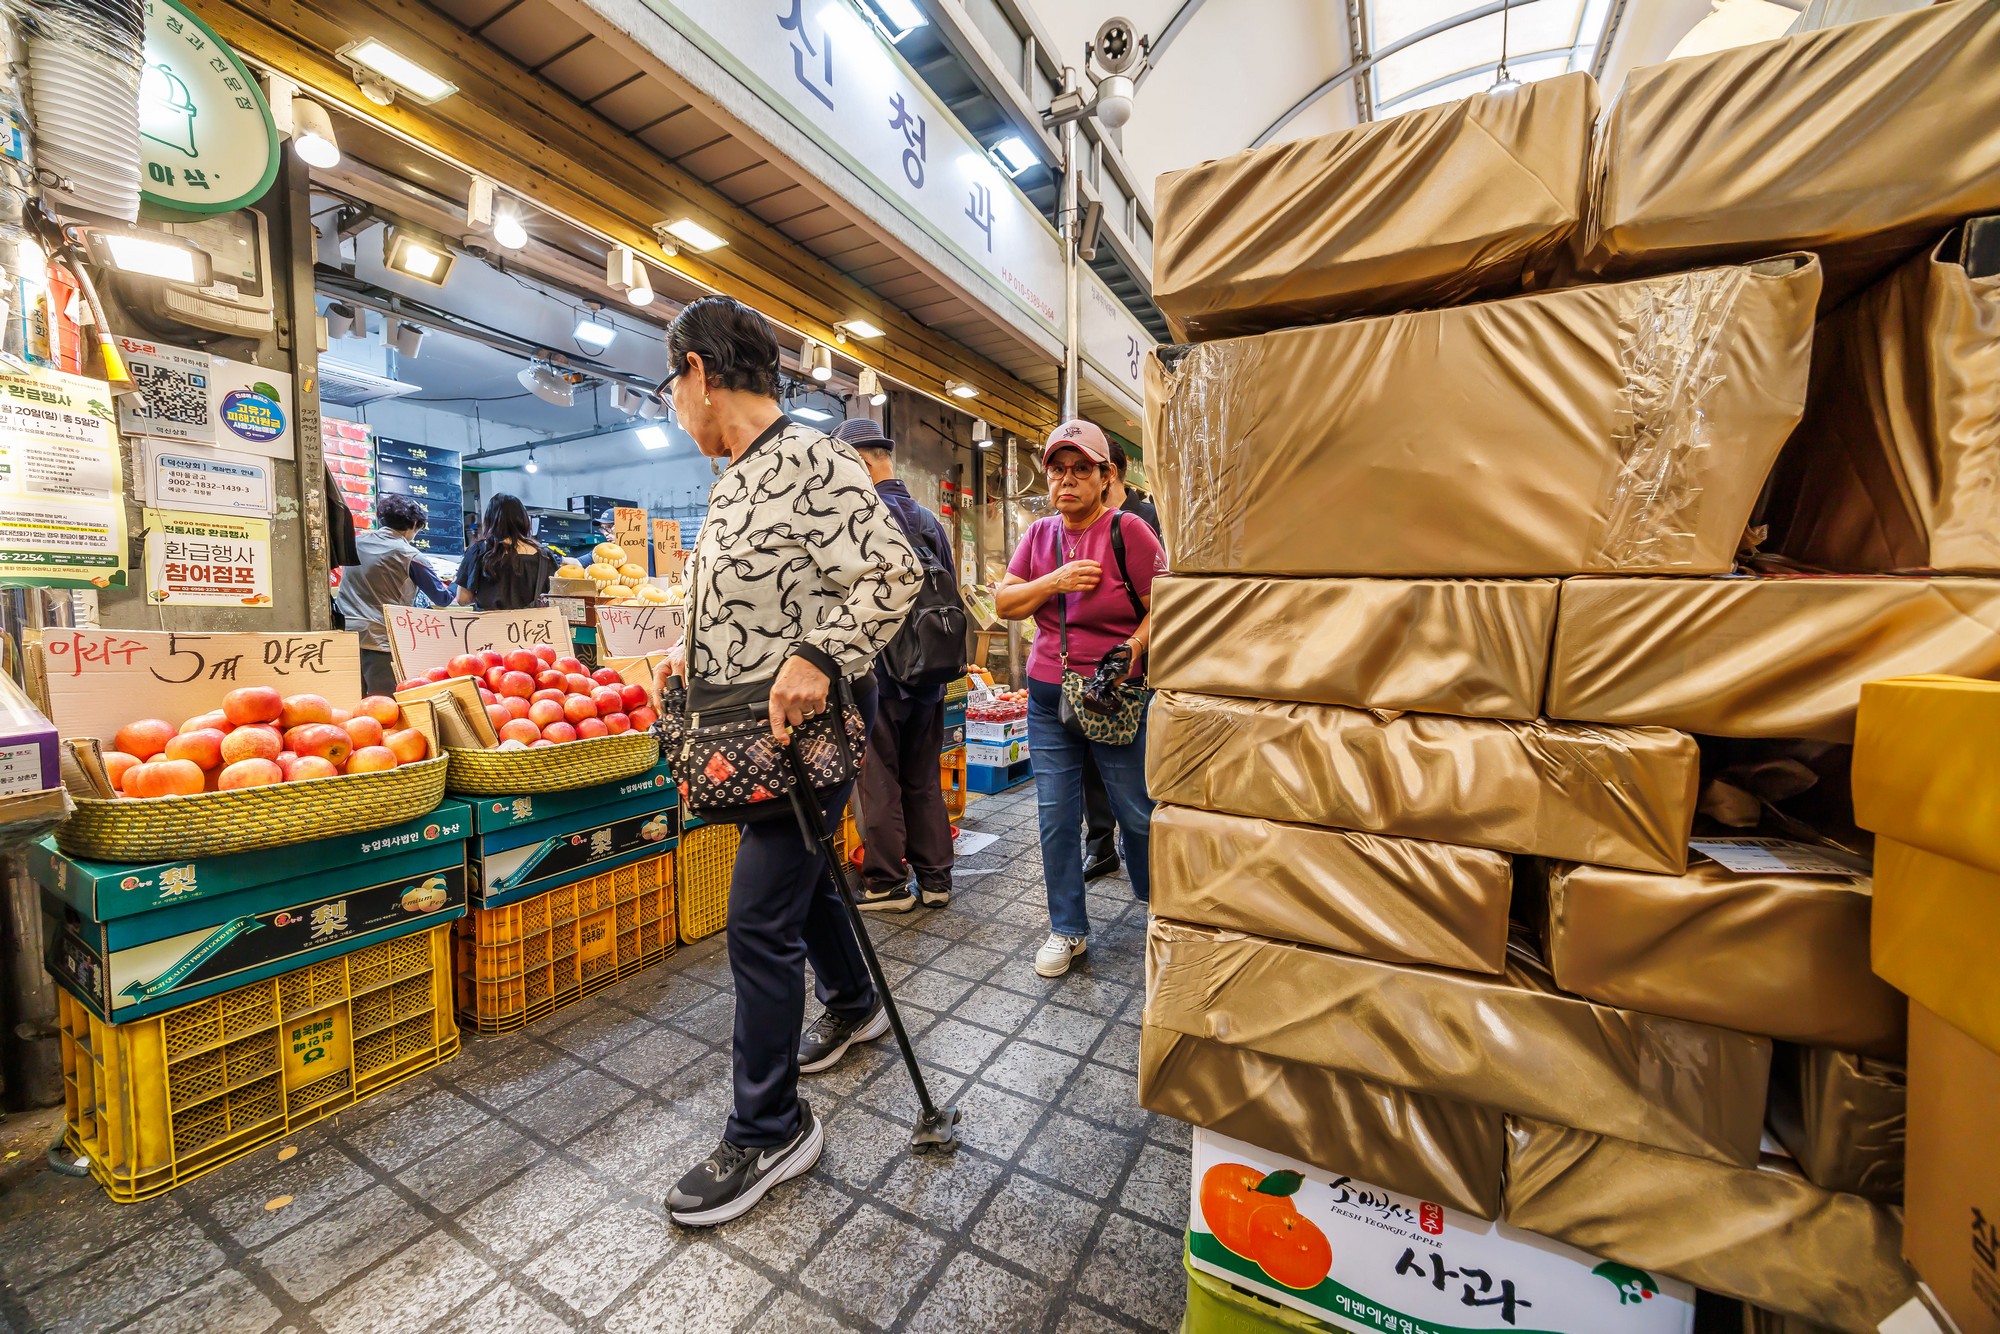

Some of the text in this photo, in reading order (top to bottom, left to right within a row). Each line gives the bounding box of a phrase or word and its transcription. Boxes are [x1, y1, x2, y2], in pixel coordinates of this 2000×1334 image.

[173, 355, 209, 369] 결제하세요
[8, 384, 72, 407] 환급행사
[15, 406, 58, 421] 20일(일)
[75, 416, 100, 429] 5일간
[227, 411, 281, 429] 피해지원금
[236, 403, 271, 417] 고유가
[156, 427, 188, 436] 덕신상회
[168, 479, 250, 493] 9002-1832-1439-3
[164, 525, 250, 540] 전통시장 환급행사
[166, 540, 255, 565] 환급행사
[165, 562, 255, 584] 참여점포
[396, 608, 446, 651] 아리수
[601, 608, 631, 634] 아리수
[50, 632, 148, 677] 아리수
[263, 637, 333, 675] 만원
[361, 832, 419, 853] 농업회사법인
[159, 864, 198, 899] 梨
[391, 895, 453, 910] Premium Pears
[310, 900, 349, 940] 梨
[146, 920, 245, 994] HIGH QUALITY FRESH GOOD FRUIT
[1329, 1176, 1440, 1234] 소백산 영주
[1330, 1205, 1444, 1249] FRESH YEONGJU APPLE
[1395, 1246, 1532, 1326] 사과
